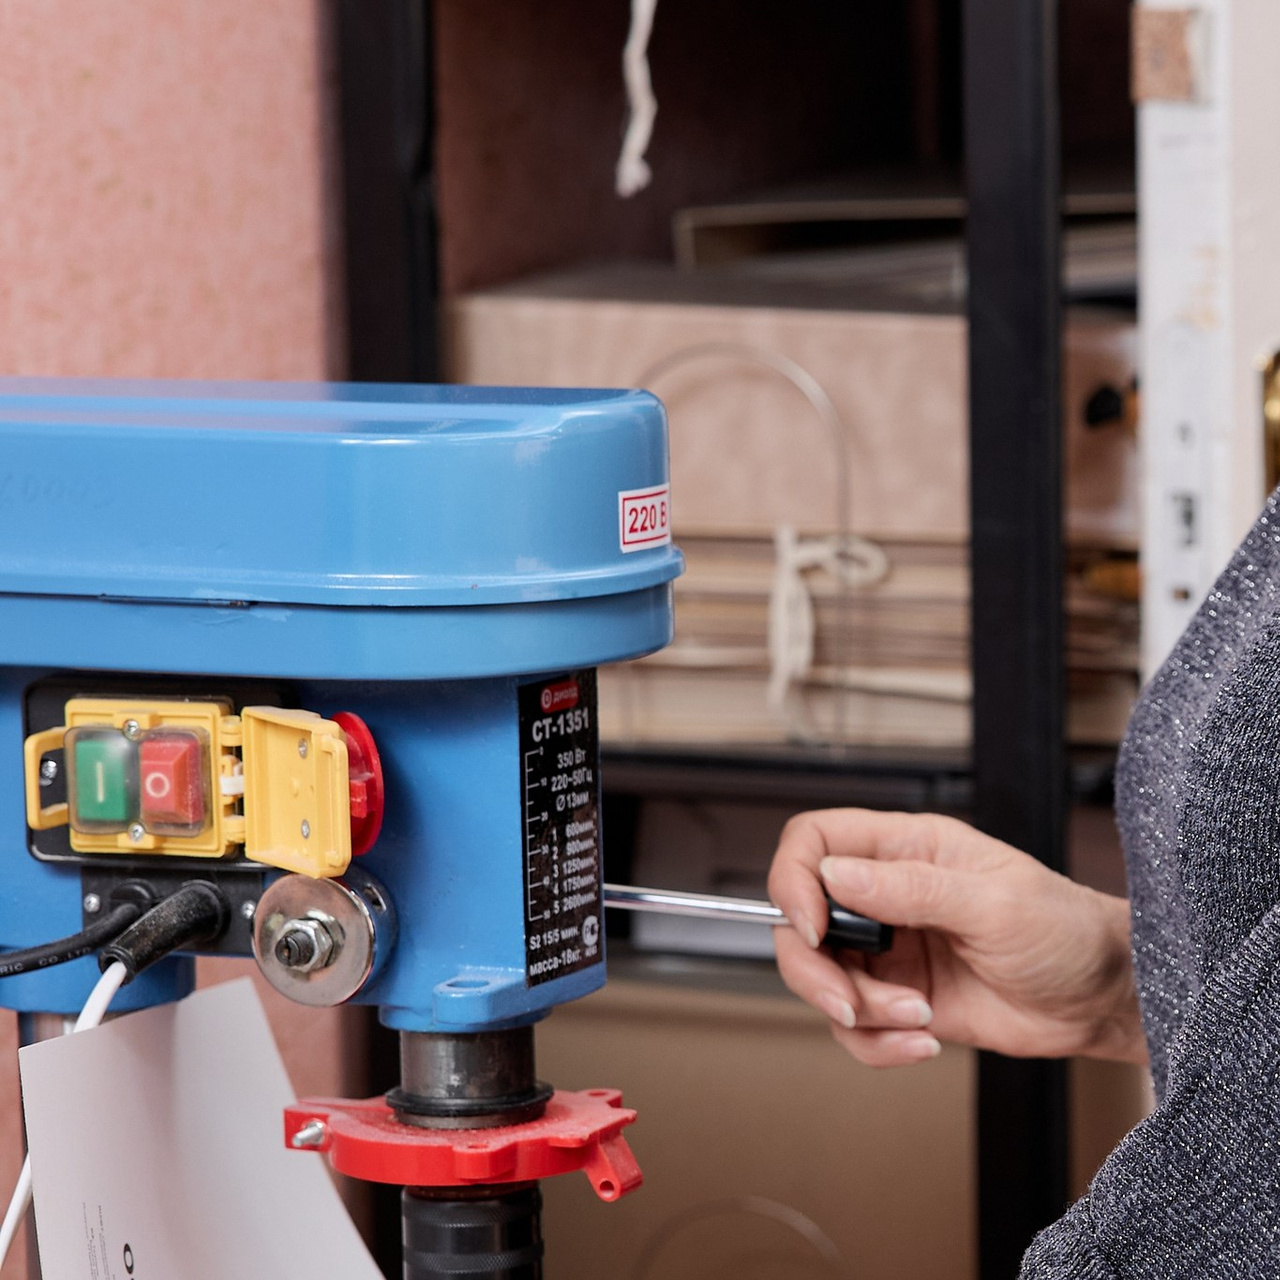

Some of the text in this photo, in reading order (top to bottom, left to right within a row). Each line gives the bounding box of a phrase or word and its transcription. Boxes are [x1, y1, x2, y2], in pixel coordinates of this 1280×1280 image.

[629, 504, 656, 534] 220
[532, 706, 589, 742] СТ-1351
[557, 748, 587, 769] 350 Вт
